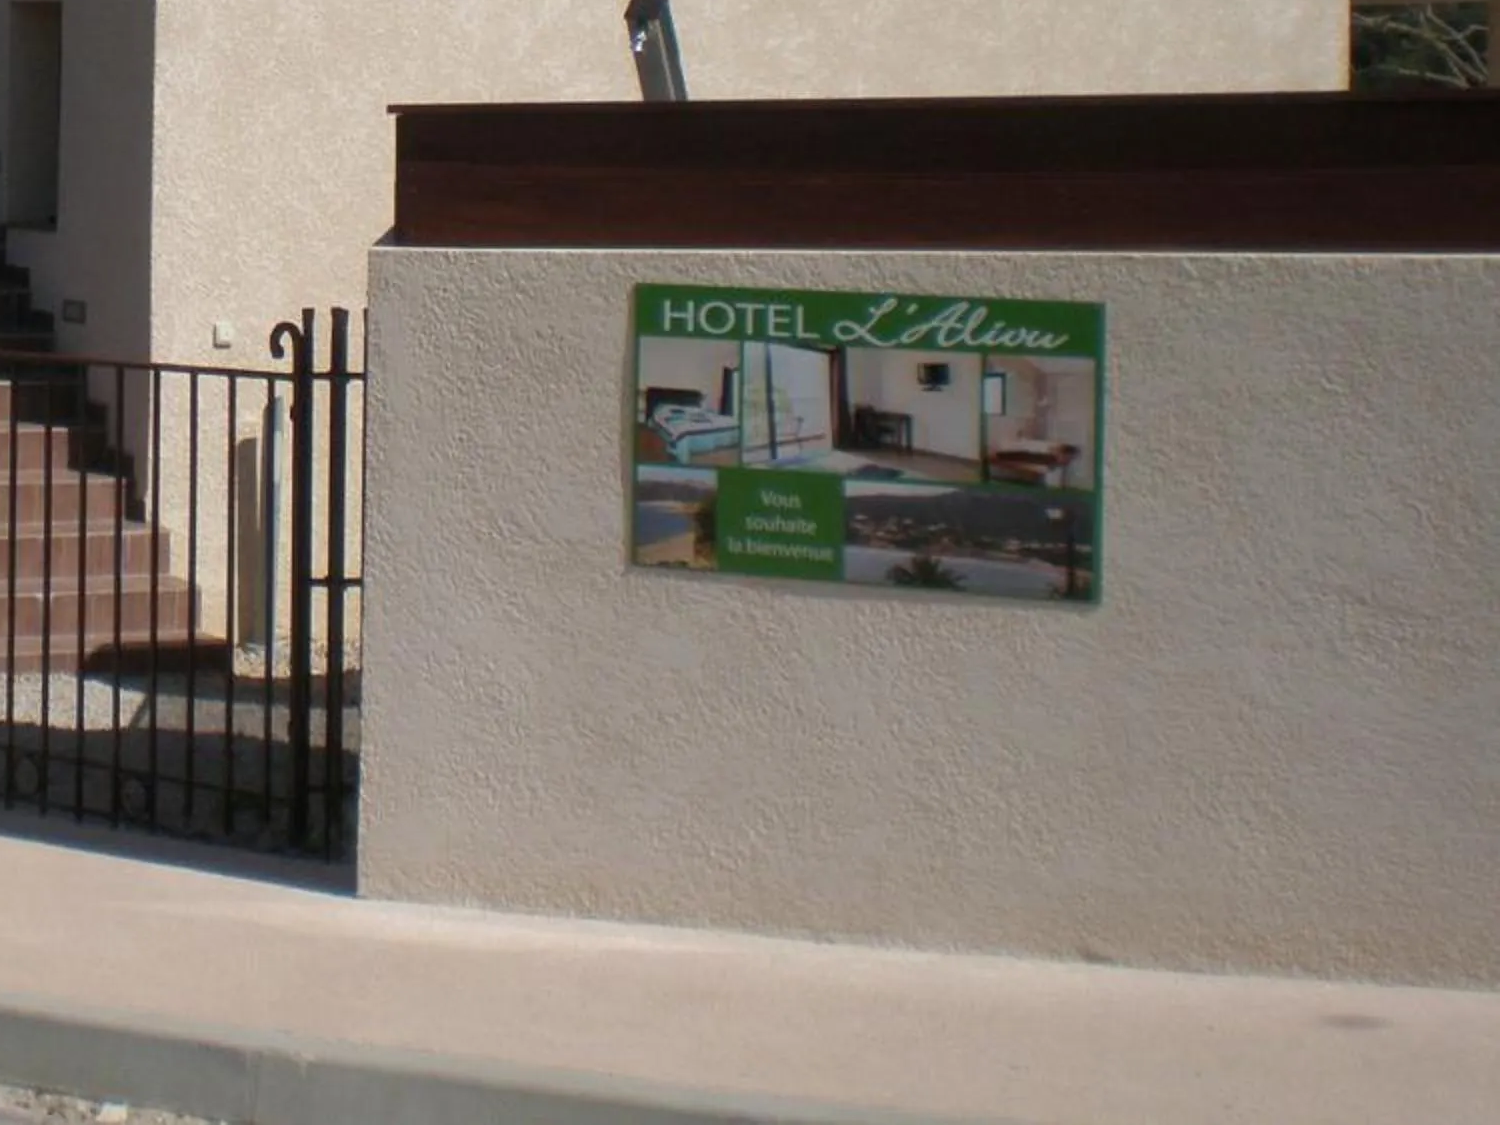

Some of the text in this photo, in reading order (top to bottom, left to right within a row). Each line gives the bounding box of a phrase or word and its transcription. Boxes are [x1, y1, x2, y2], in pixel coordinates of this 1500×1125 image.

[663, 299, 821, 339] HOTEL
[761, 490, 802, 510] Vous
[744, 514, 818, 536] souhaite
[746, 539, 835, 563] bienvenue
